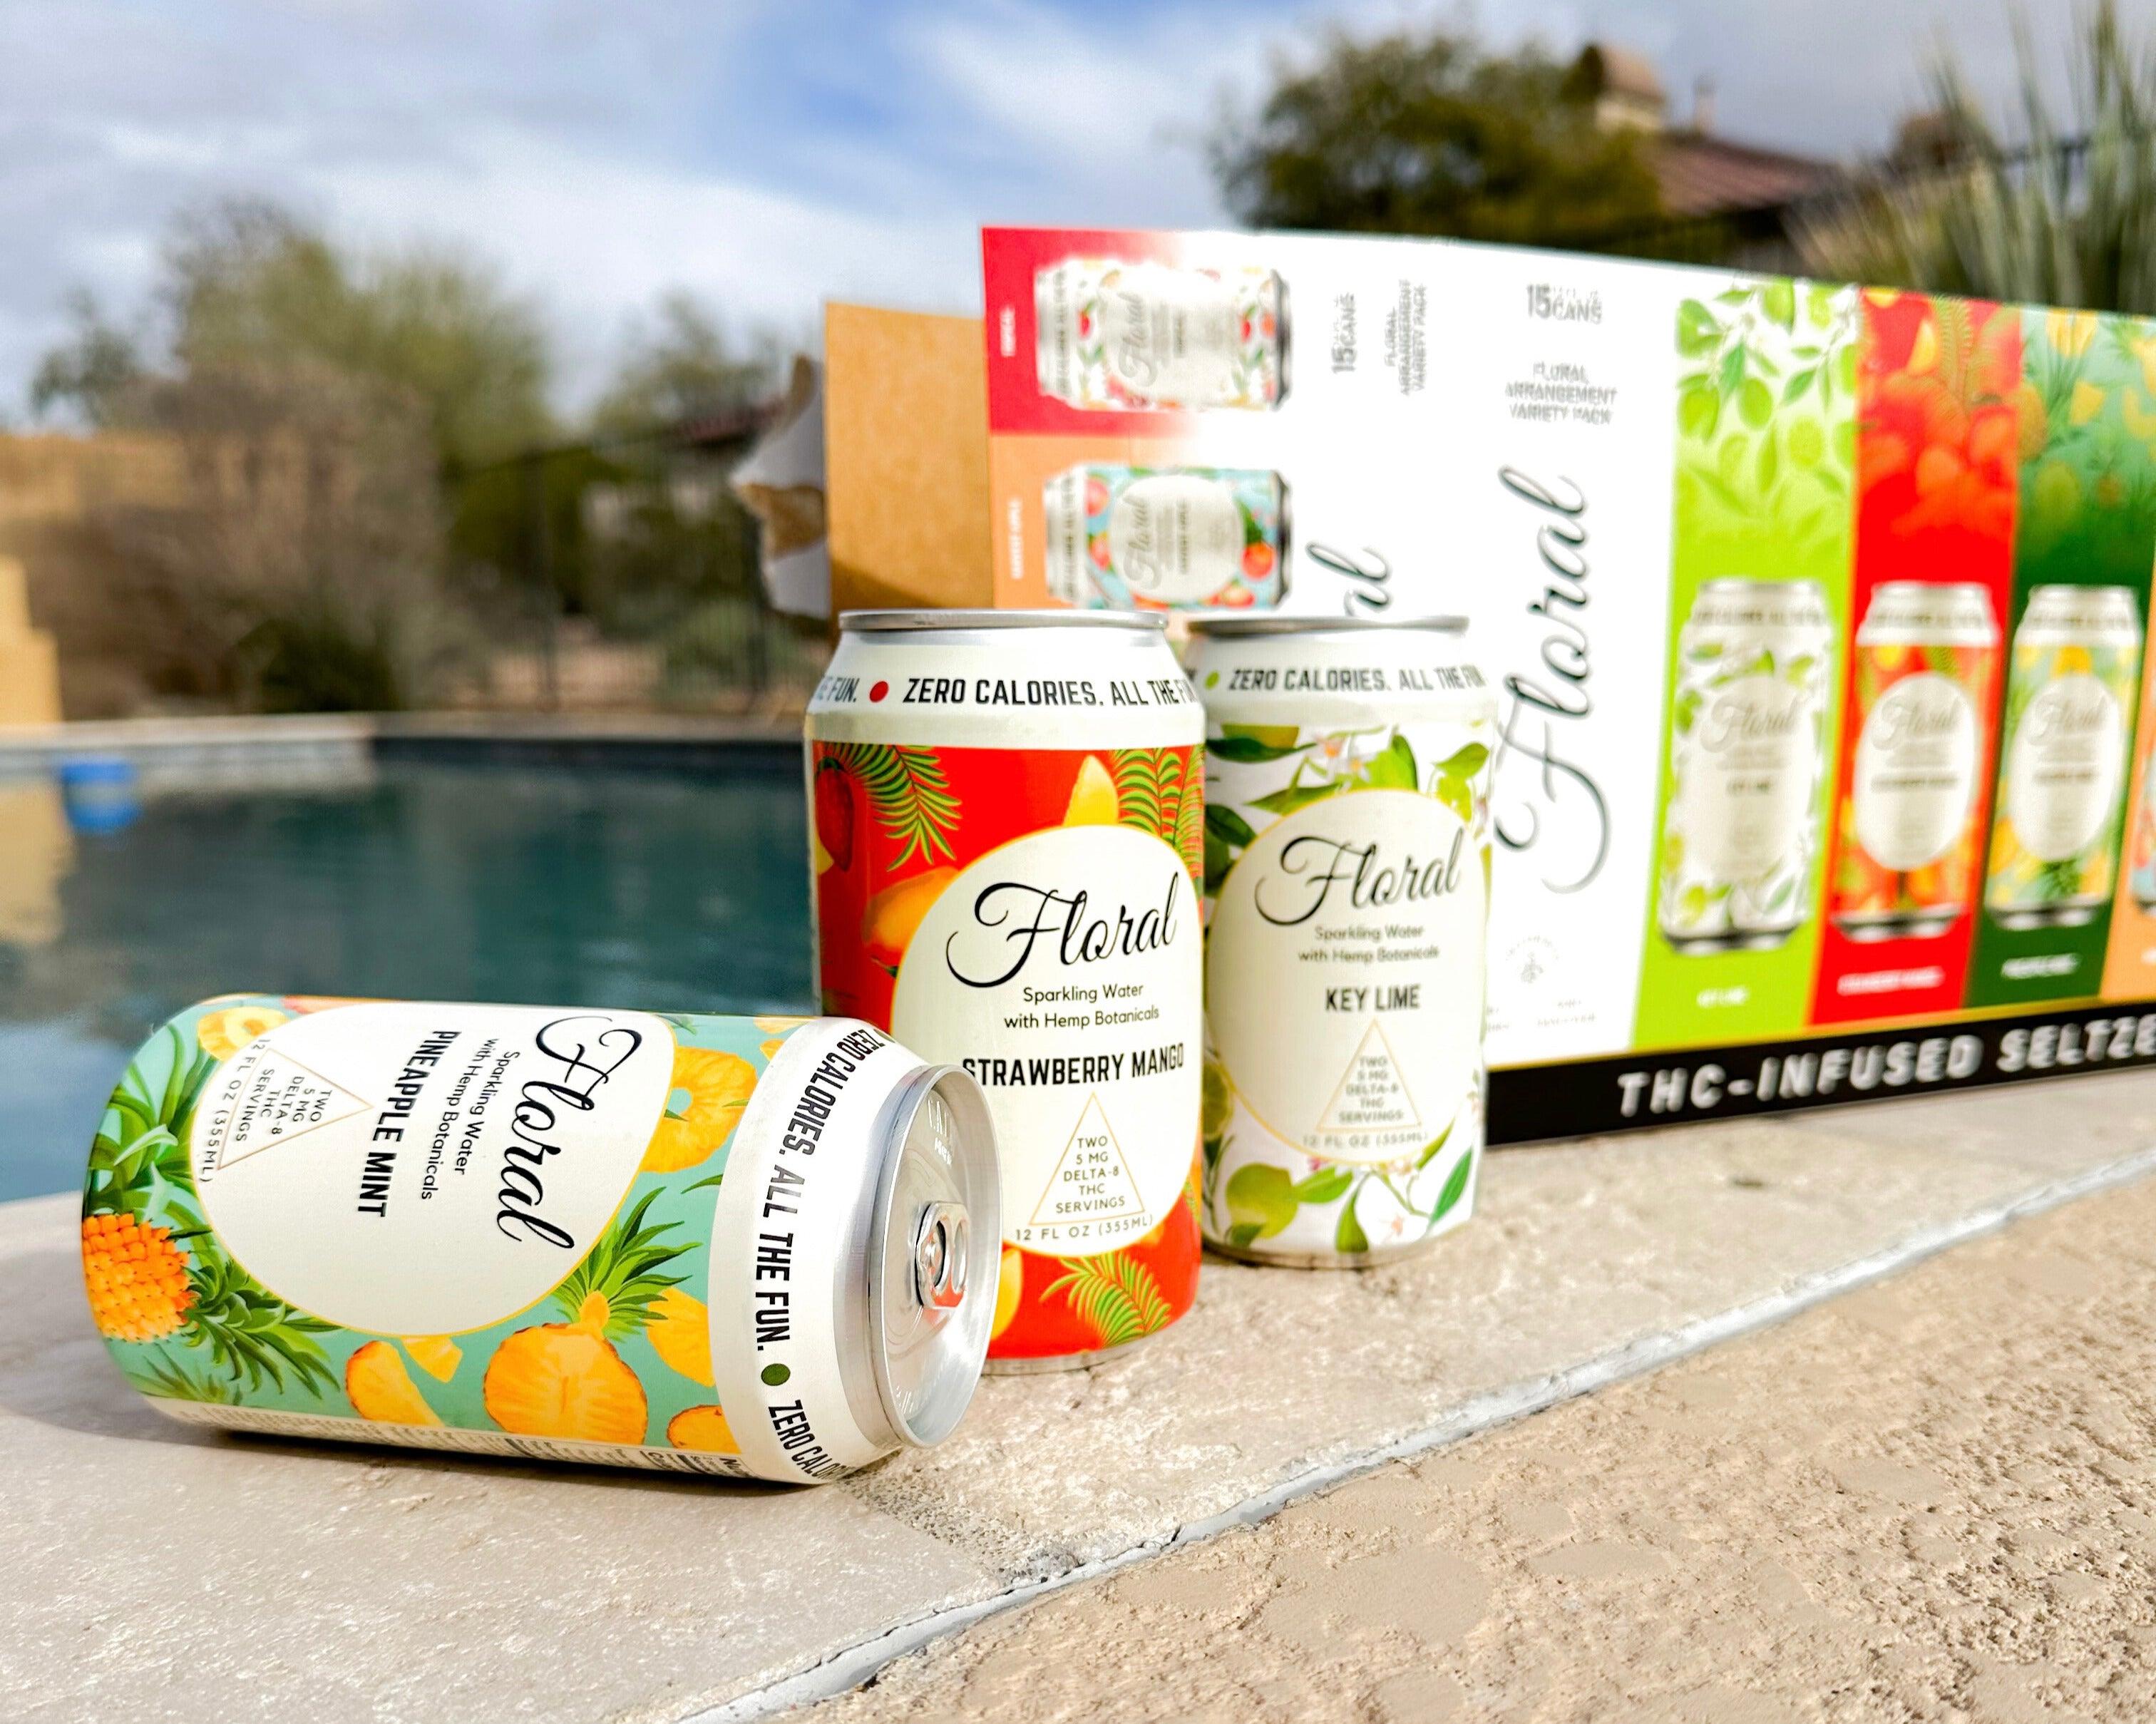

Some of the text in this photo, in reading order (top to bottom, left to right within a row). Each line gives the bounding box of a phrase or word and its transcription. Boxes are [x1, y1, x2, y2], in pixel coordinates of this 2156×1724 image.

[1527, 284, 1551, 319] 15
[1331, 347, 1356, 373] 15
[828, 677, 860, 703] FUN.
[903, 678, 965, 703] ZERO
[975, 679, 1104, 705] CALORIES.
[1110, 681, 1149, 706] ALL
[1146, 680, 1180, 705] THE
[1229, 669, 1277, 691] ZERO
[1284, 668, 1392, 692] CALORIES.
[1398, 669, 1434, 691] ALL
[1433, 666, 1465, 689] THE
[1496, 464, 1613, 895] Floral
[1254, 827, 1464, 925] Floral
[946, 871, 1179, 987] Floral
[1315, 925, 1423, 943] Sparkling Water
[1298, 947, 1328, 961] with
[1333, 948, 1374, 965] Hemp
[1023, 983, 1144, 1005] Sparkling Water
[1325, 984, 1420, 1012] KEY LIME
[1004, 1005, 1159, 1030] with Hemp Botanicals
[836, 1029, 886, 1061] ZERO
[1359, 1056, 1387, 1067] TWO
[962, 1042, 1184, 1086] STRAWBERRY MANGO
[1618, 1014, 2156, 1117] THC-INFUSED SELTZE
[199, 1039, 271, 1182] 12 FL OZ (355ML)
[235, 1069, 274, 1141] SERVINGS
[260, 1089, 281, 1118] THC
[271, 1076, 304, 1134] DELTA-8
[292, 1100, 310, 1122] MG
[310, 1089, 332, 1122] TWO
[421, 1038, 499, 1200] with Hemp Botanicals
[454, 1051, 520, 1176] Sparkling Water
[779, 1052, 856, 1155] CALORIES.
[357, 1031, 462, 1217] PINEAPPLE MINT
[497, 1016, 642, 1248] Floral
[1076, 1152, 1109, 1165] 5 MG
[1077, 1136, 1109, 1149] TWO
[1064, 1166, 1119, 1182] DELTA-8
[1079, 1183, 1105, 1196] THC
[763, 1164, 805, 1218] ALL
[1056, 1196, 1125, 1214] SERVINGS
[1016, 1214, 1154, 1241] 12 FL OZ (355ML)
[756, 1233, 794, 1281] THE
[755, 1292, 790, 1350] FUN.
[768, 1399, 815, 1450] ZERO
